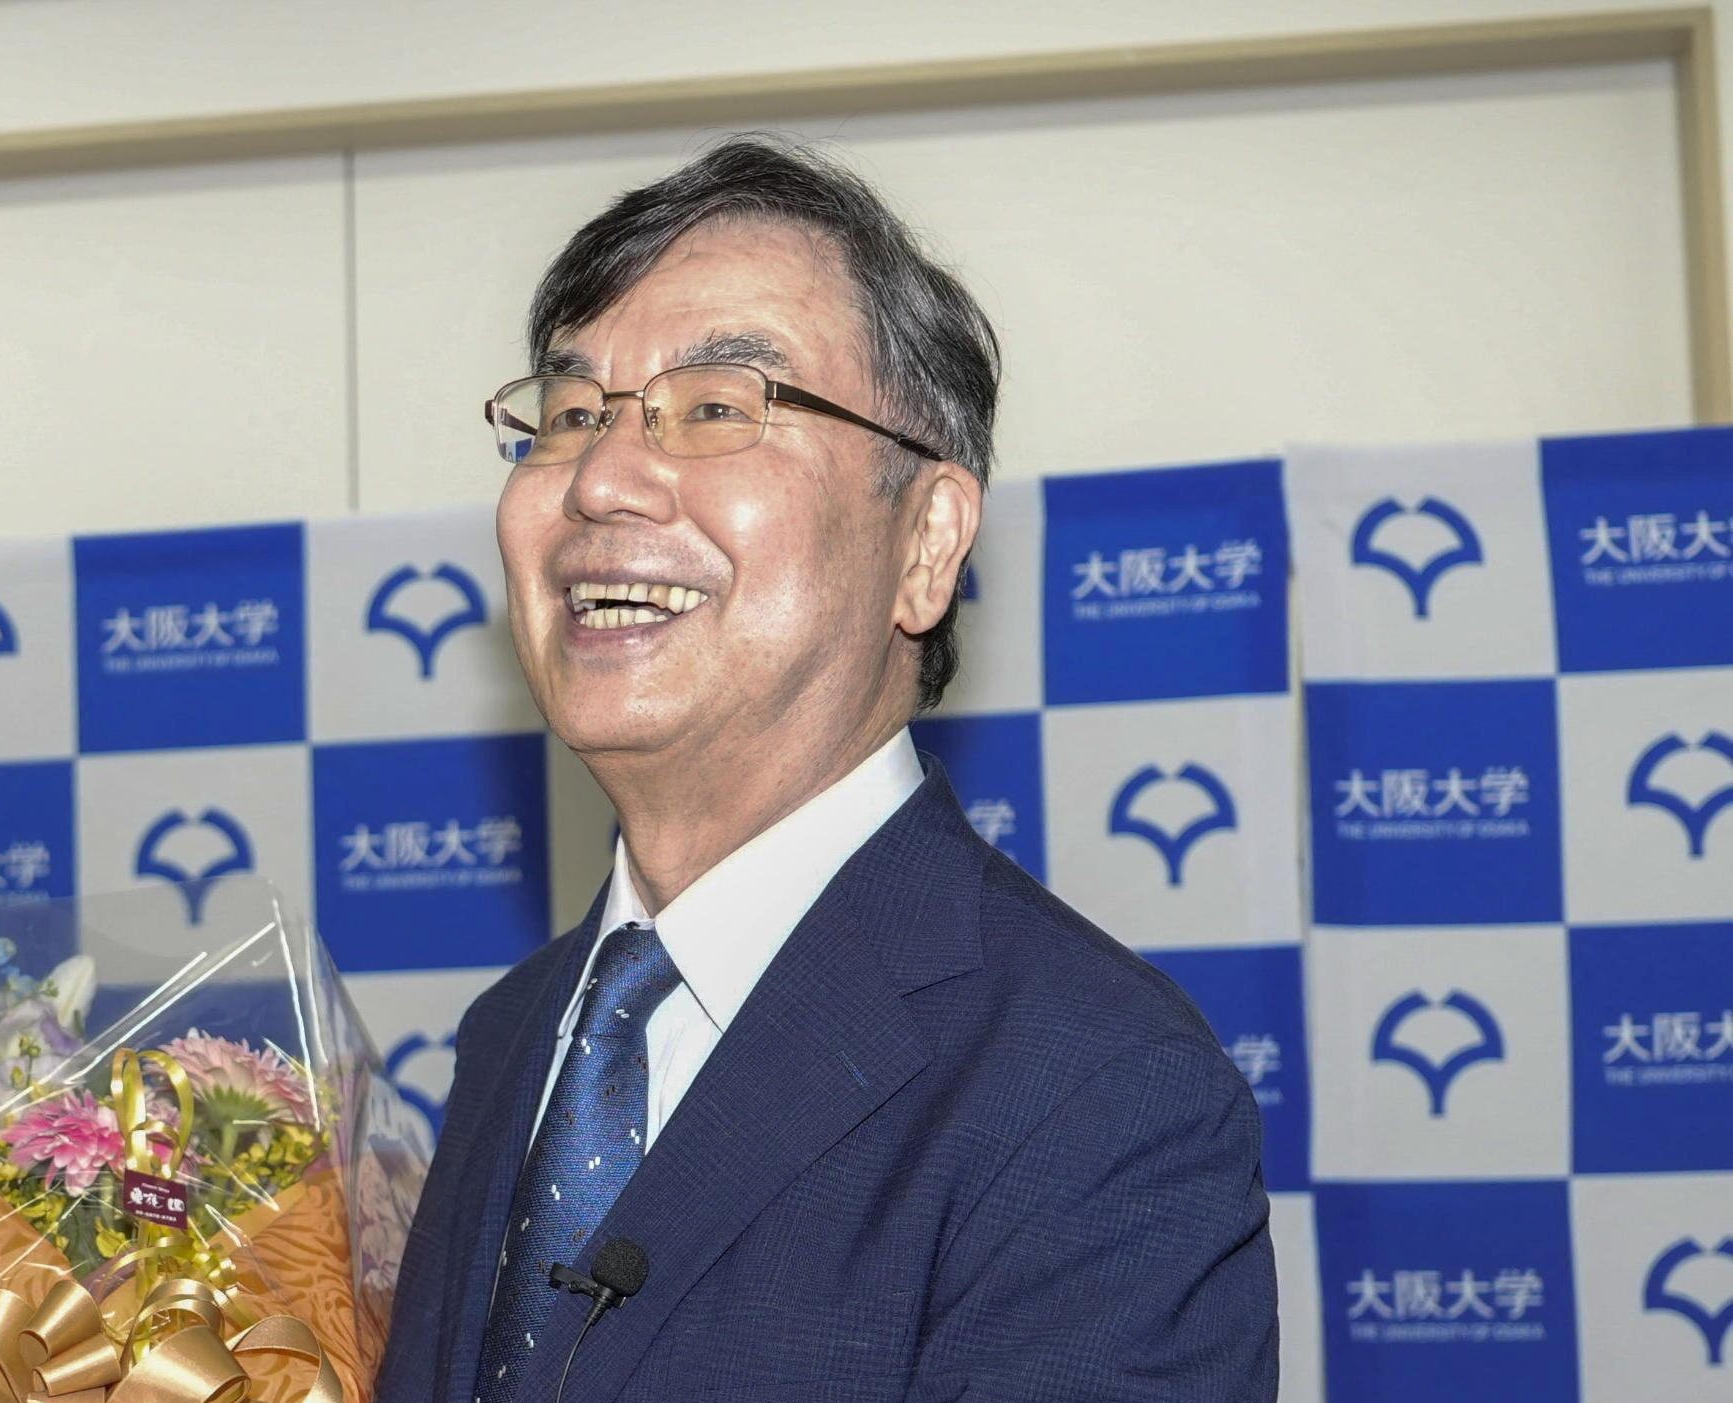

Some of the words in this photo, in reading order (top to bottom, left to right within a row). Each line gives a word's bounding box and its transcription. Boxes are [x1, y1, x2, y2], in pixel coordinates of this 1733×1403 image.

[1580, 510, 1733, 565] 大阪大
[1071, 539, 1262, 600] 大阪大学
[101, 599, 279, 652] 大阪大学
[1335, 766, 1530, 817] 大阪大学
[339, 816, 522, 871] 大阪大学
[1347, 1269, 1544, 1319] 大阪大学
